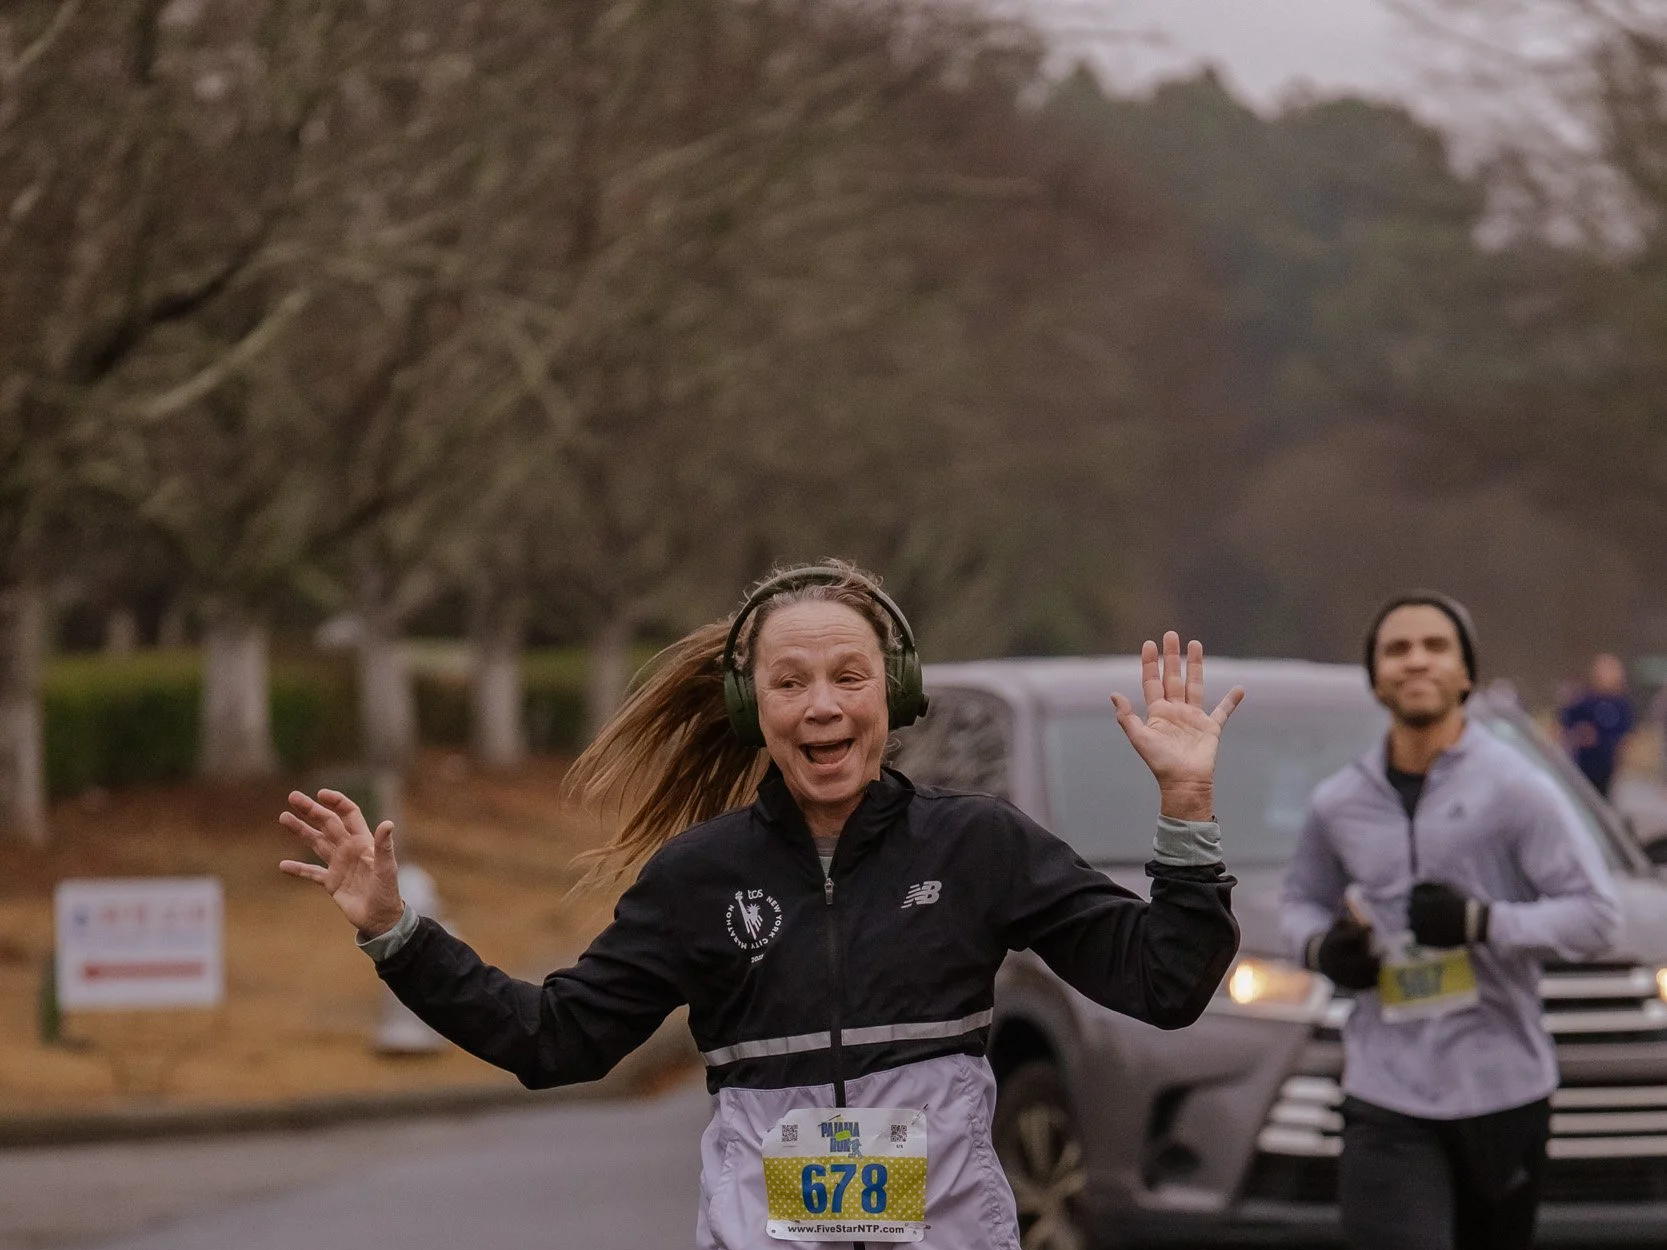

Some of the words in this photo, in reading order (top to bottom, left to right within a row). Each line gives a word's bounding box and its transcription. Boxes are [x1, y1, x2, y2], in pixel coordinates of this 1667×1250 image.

[766, 896, 782, 913] NEW
[726, 904, 747, 950] MARATHON
[769, 914, 783, 938] YORK
[751, 938, 769, 949] CITY
[801, 1163, 888, 1214] 678
[788, 1224, 905, 1234] www.FiveStarNTP.com
